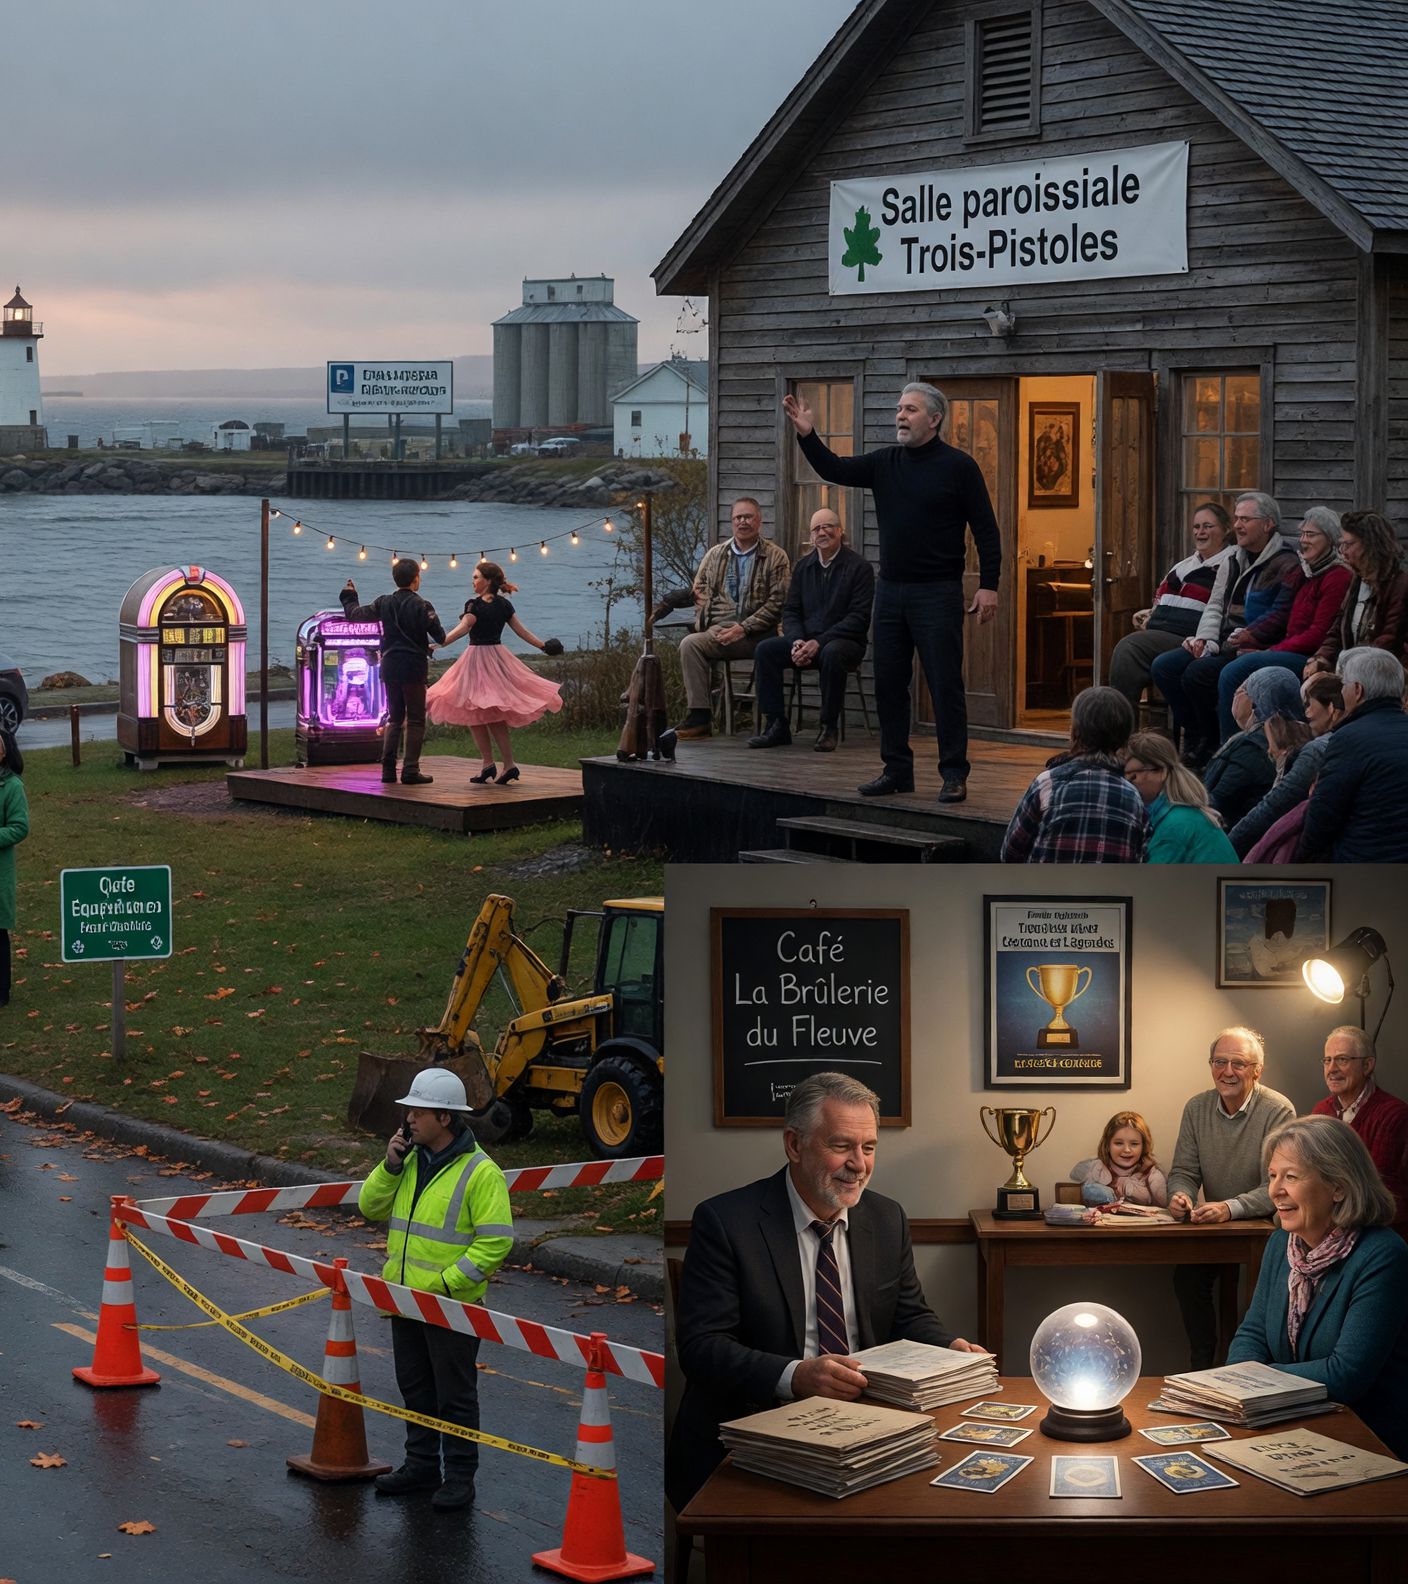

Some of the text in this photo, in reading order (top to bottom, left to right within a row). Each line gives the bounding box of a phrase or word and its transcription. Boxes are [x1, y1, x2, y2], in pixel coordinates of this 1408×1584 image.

[880, 164, 1141, 229] Salle paroissiale
[900, 222, 1119, 275] Trois-Pistoles
[777, 931, 845, 964] Café
[735, 972, 889, 1005] La Brûlerie
[746, 1015, 878, 1046] du Fleuve
